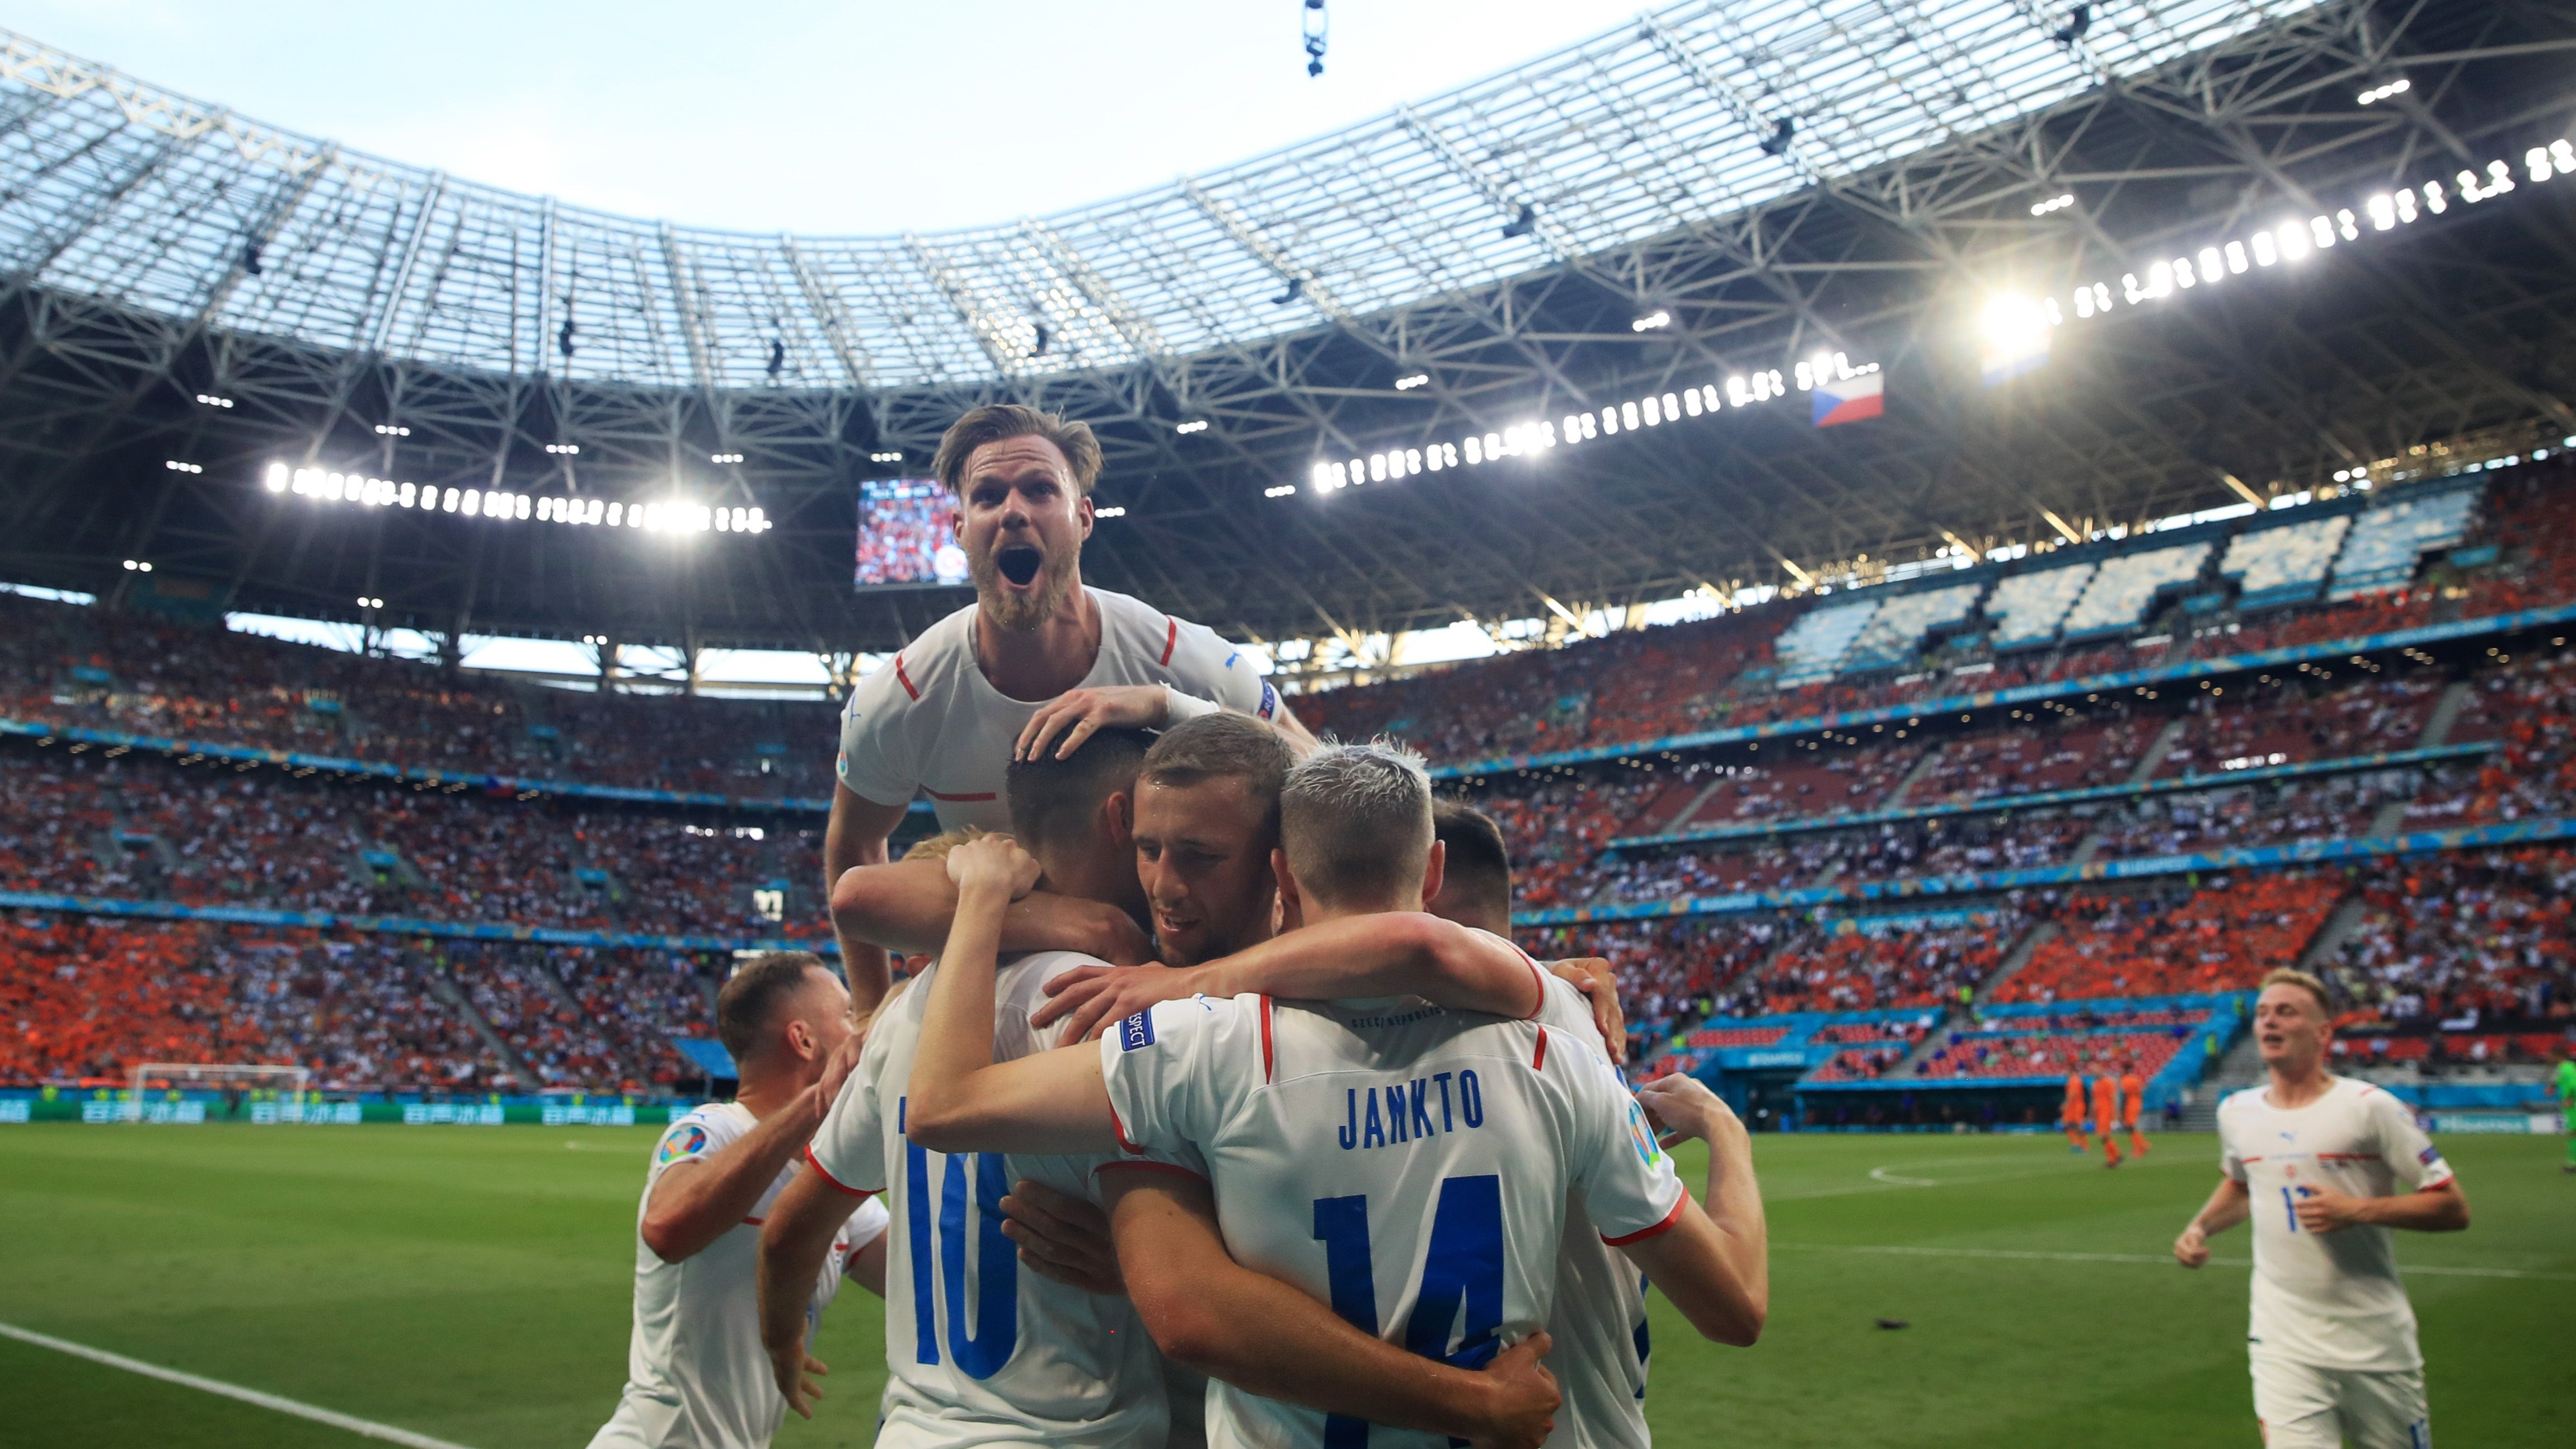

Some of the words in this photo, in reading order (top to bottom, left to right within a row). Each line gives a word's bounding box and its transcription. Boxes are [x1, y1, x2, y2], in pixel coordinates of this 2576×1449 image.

[1128, 1012, 1146, 1046] SPECT
[1339, 1069, 1484, 1150] JANKTO
[899, 1096, 1018, 1381] 10
[2279, 1184, 2310, 1234] 1
[1313, 1174, 1505, 1449] 14
